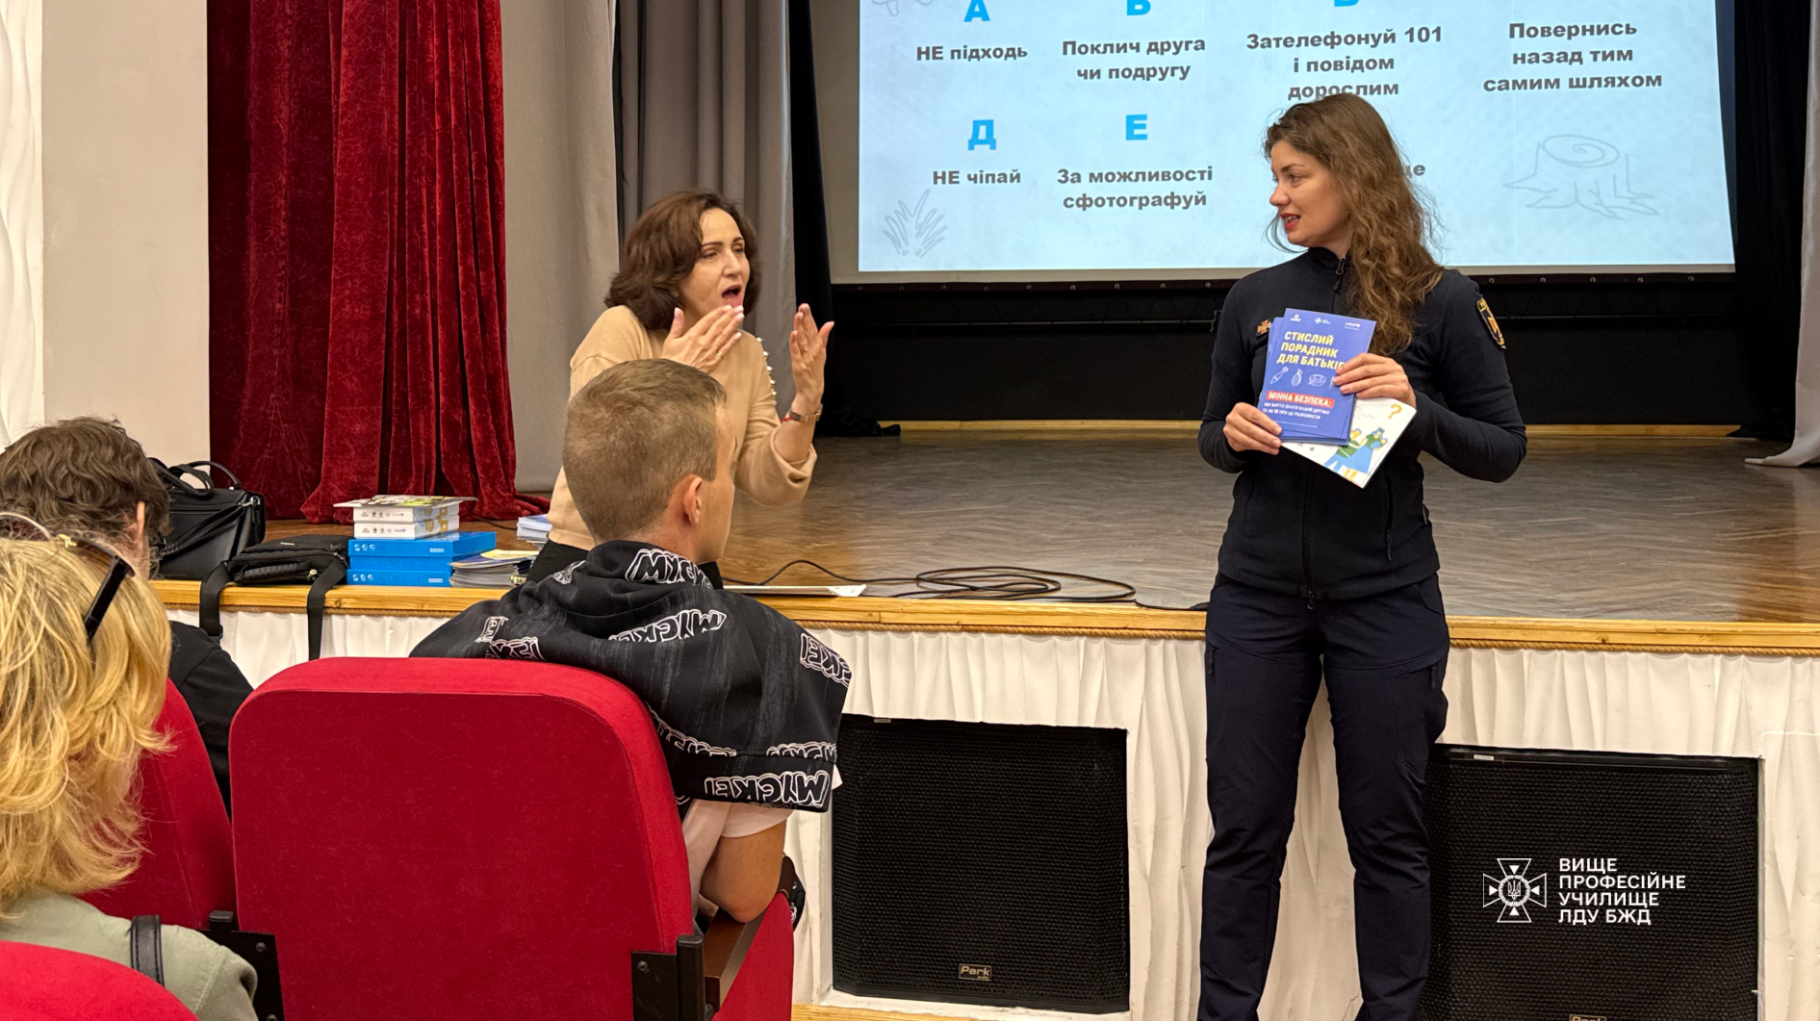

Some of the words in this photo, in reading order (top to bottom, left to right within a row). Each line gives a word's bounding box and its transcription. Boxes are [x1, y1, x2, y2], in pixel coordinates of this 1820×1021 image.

[963, 0, 990, 22] А
[1246, 28, 1396, 50] Зателефонуй
[1404, 26, 1442, 43] 101
[1509, 22, 1637, 41] Повернись
[916, 46, 944, 61] НЕ
[950, 44, 1028, 62] підходь
[1062, 40, 1140, 56] Поклич
[1146, 38, 1206, 56] друга
[1293, 57, 1299, 73] і
[1306, 55, 1394, 74] повідом
[1512, 51, 1584, 66] назад
[1589, 49, 1633, 62] тим
[1077, 68, 1101, 80] чи
[1108, 65, 1191, 82] подругу
[1287, 83, 1399, 101] дорослим
[1483, 78, 1560, 92] самим
[1568, 75, 1662, 90] шляхом
[968, 119, 997, 151] Д
[1125, 114, 1148, 141] Е
[933, 170, 960, 185] НЕ
[967, 169, 1021, 184] чіпай
[1057, 168, 1082, 184] За
[1089, 165, 1213, 183] можливості
[1063, 191, 1207, 211] сфотографуй
[1283, 331, 1335, 346] СТИСЛИЙ
[1276, 353, 1300, 365] ДЛЯ
[1280, 342, 1338, 358] ПОРАДНИК
[1268, 391, 1293, 402] МІННА
[1294, 394, 1332, 407] БЕЗПЕКА:
[960, 965, 991, 976] Park
